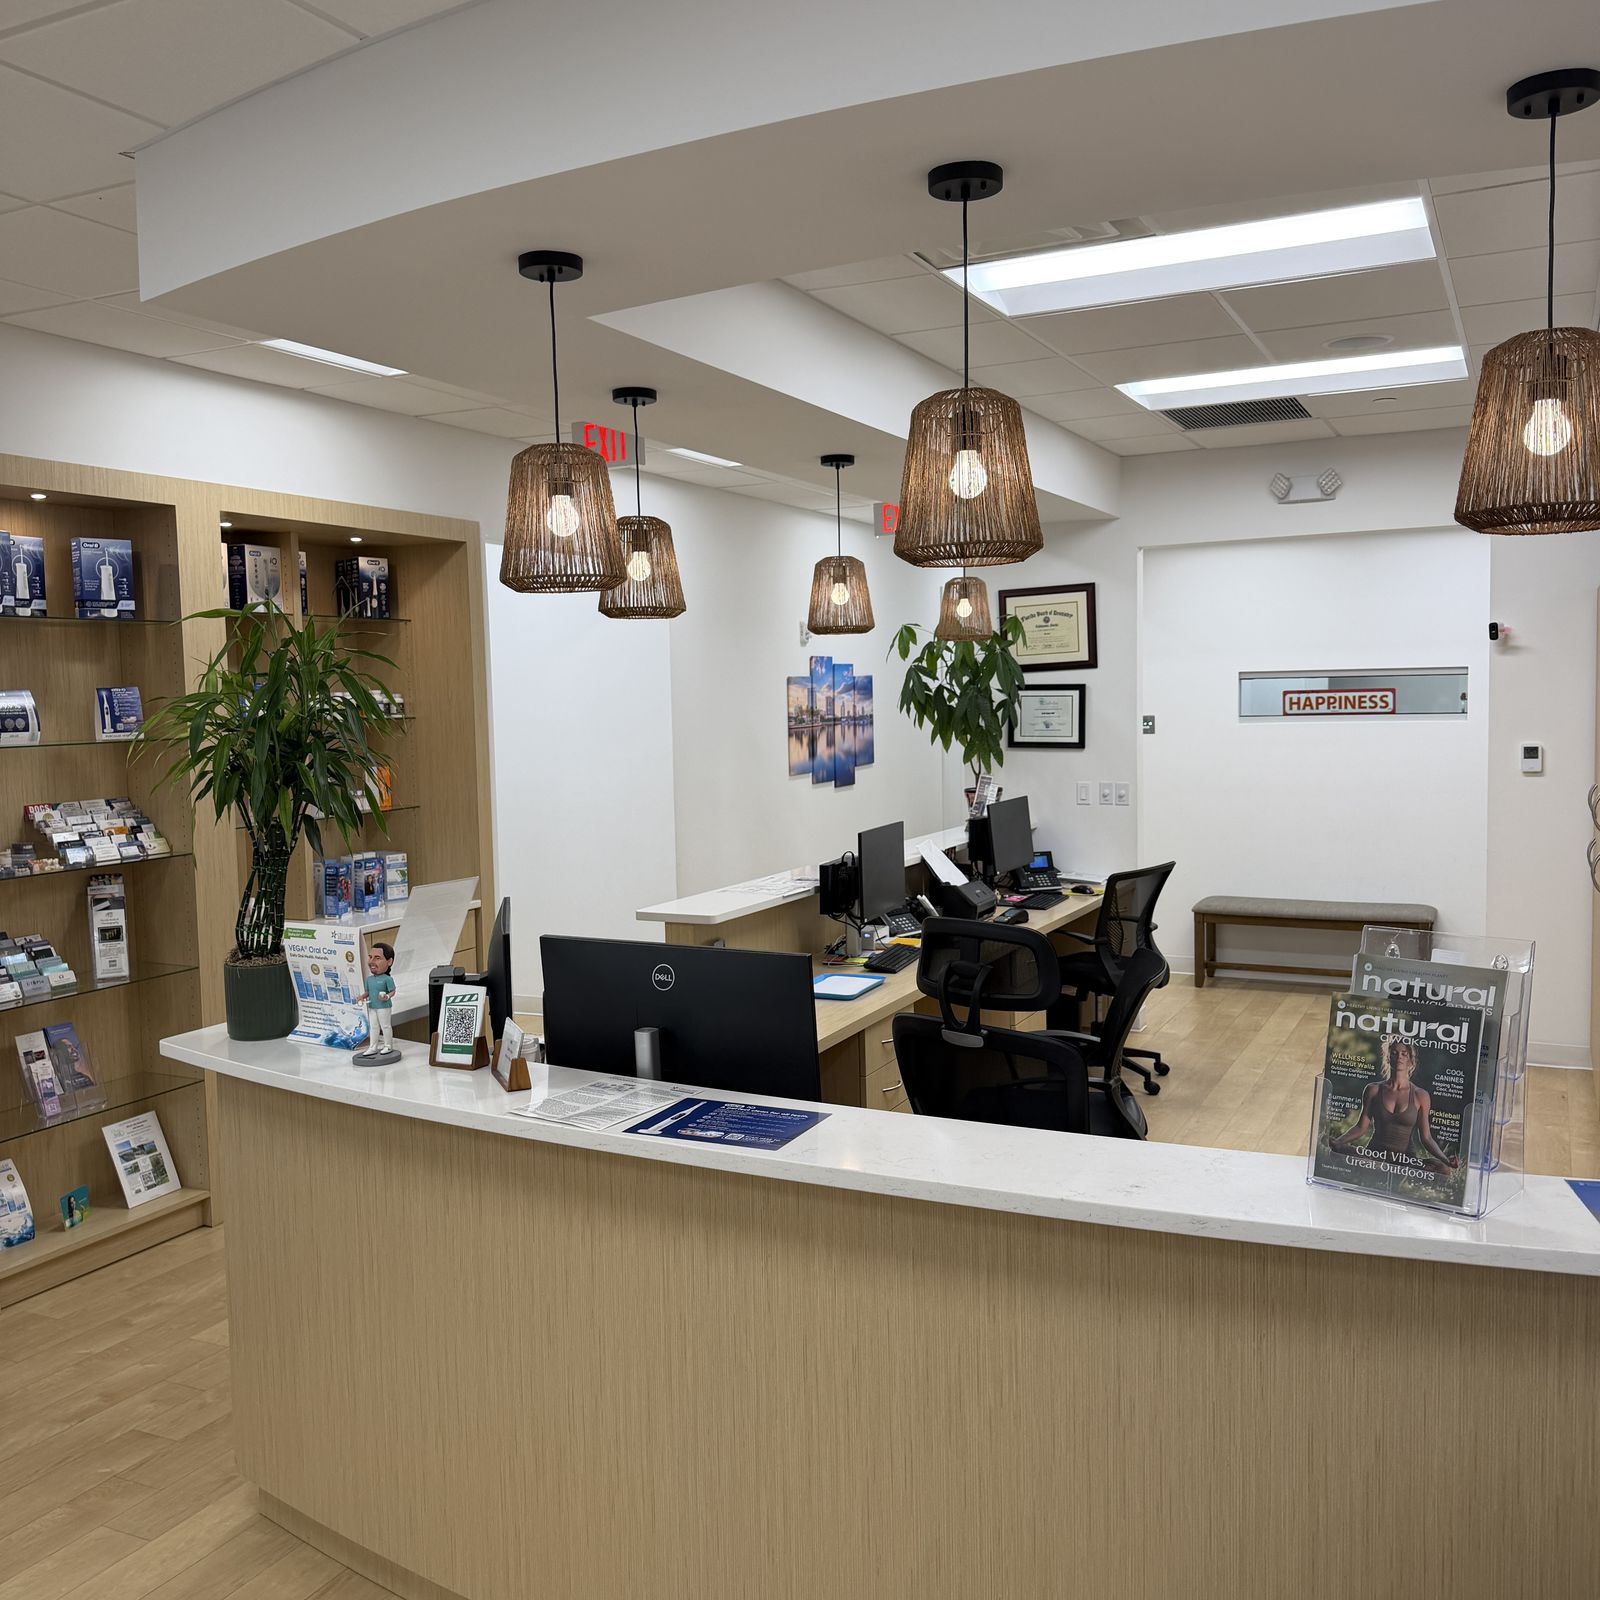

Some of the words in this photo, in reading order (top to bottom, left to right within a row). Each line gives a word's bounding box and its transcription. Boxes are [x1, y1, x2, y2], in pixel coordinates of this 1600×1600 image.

[1289, 695, 1389, 710] HAPPINESS
[28, 804, 50, 814] DOCS
[309, 946, 321, 954] Oral
[322, 947, 337, 955] Care
[1362, 974, 1496, 1007] natural
[1336, 1011, 1469, 1043] natural
[1380, 1033, 1466, 1054] awakenings
[1332, 1053, 1365, 1063] WELLNESS
[1332, 1059, 1356, 1067] Without
[1446, 1069, 1465, 1077] COOL
[1434, 1074, 1464, 1084] CANINES
[1328, 1093, 1354, 1102] Summer
[1328, 1099, 1345, 1108] Every
[1429, 1110, 1460, 1120] Pickleball
[1432, 1117, 1460, 1127] FITNESS
[1356, 1145, 1387, 1160] Good
[1391, 1151, 1426, 1168] Vibes,
[1346, 1155, 1376, 1169] Great
[1380, 1163, 1435, 1181] Outdoors
